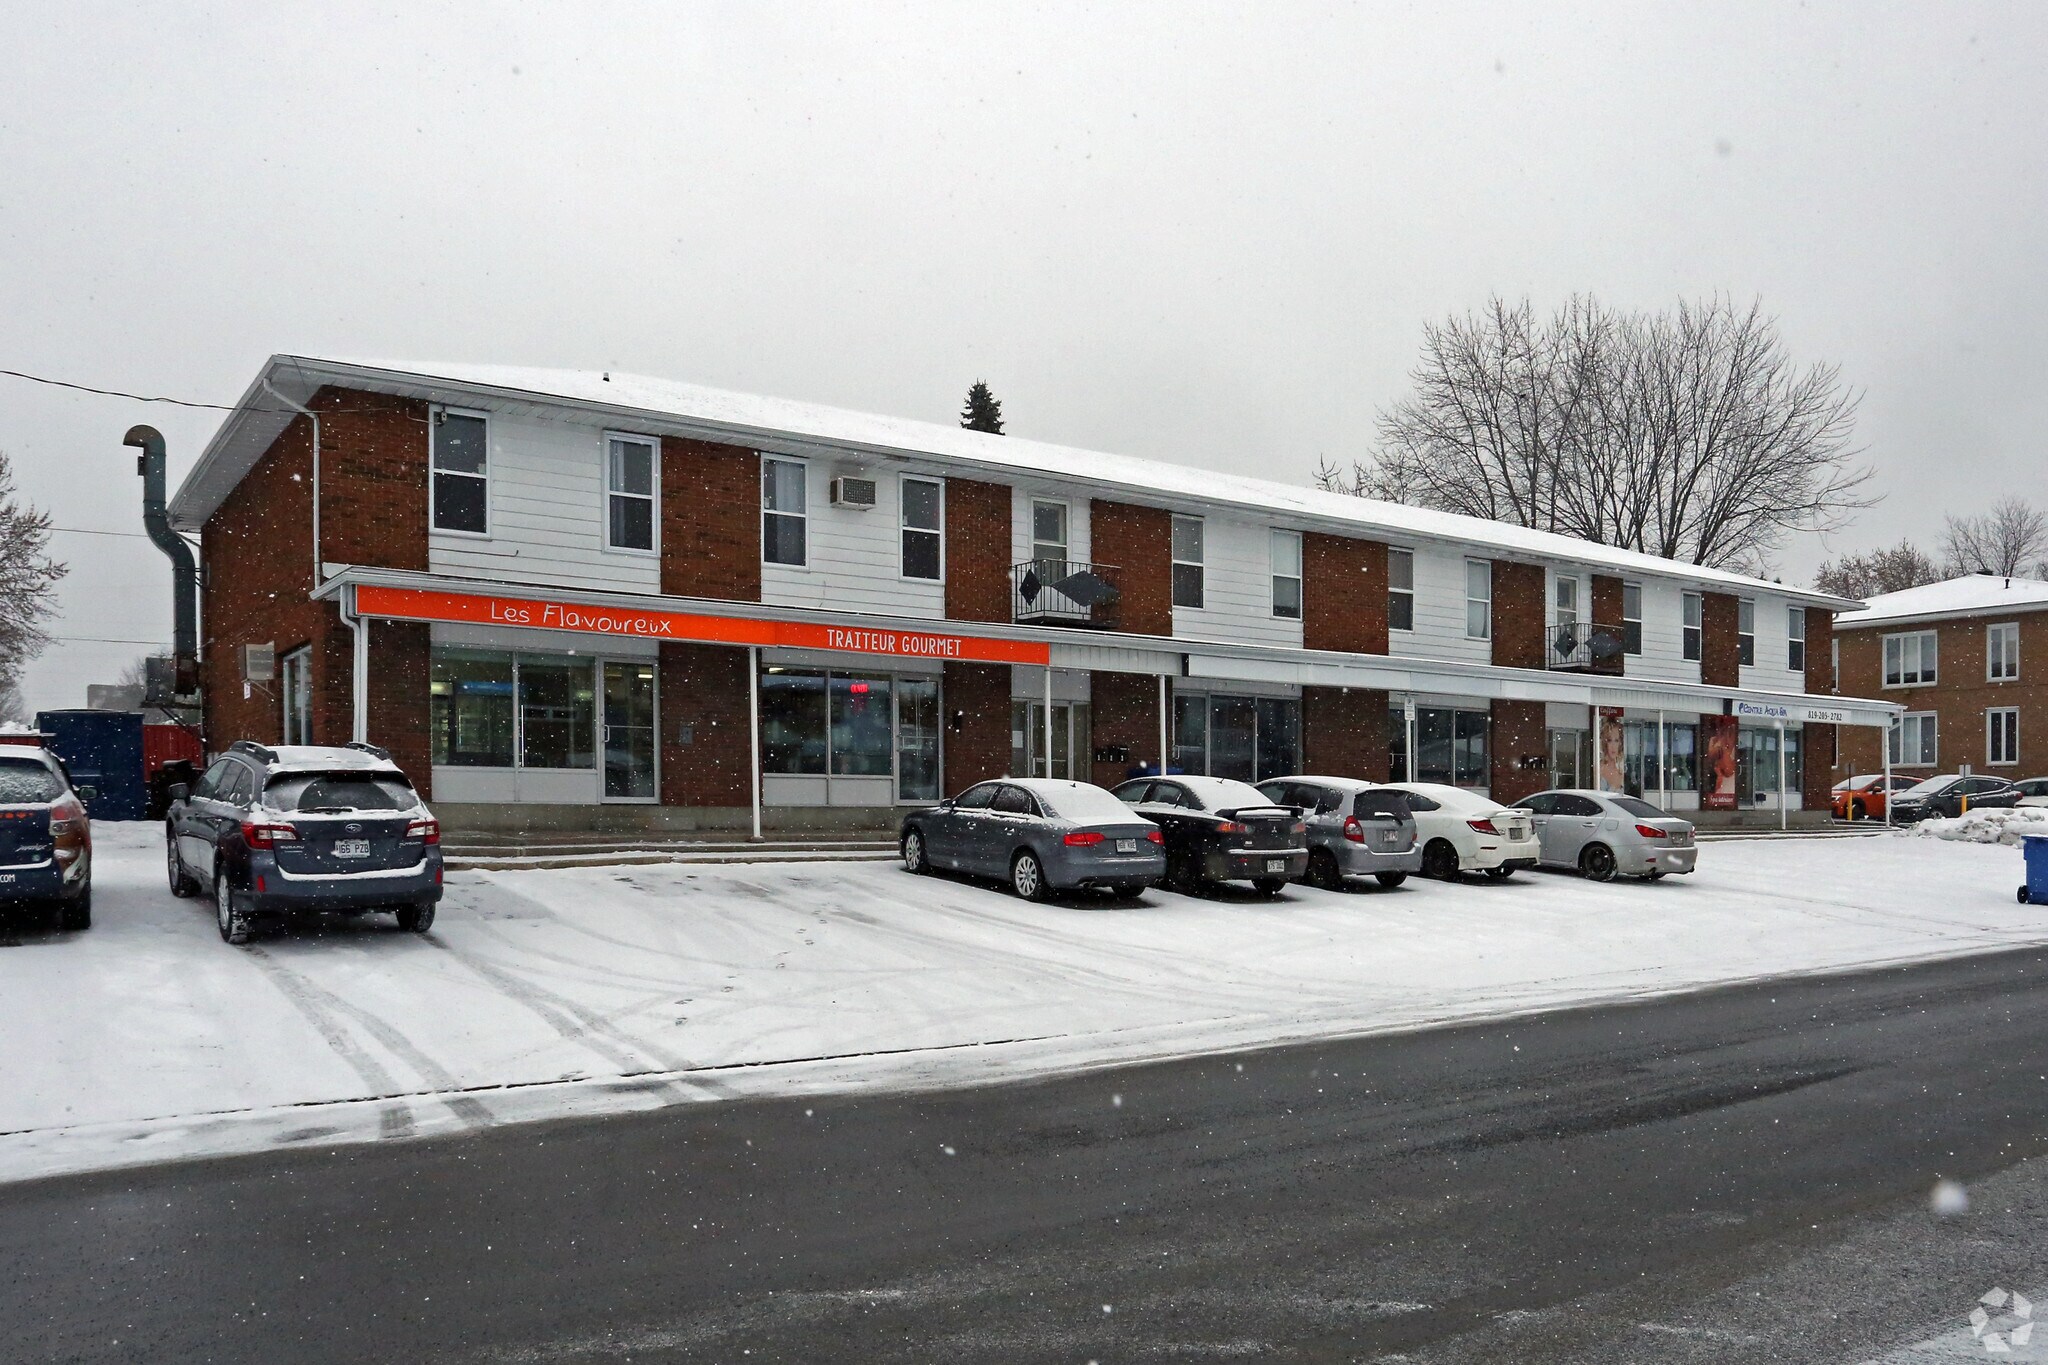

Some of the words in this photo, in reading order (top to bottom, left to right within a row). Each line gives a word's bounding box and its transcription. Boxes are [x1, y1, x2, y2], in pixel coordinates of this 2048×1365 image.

[491, 601, 530, 622] Les
[543, 604, 672, 633] Flavoureux
[827, 629, 895, 652] TRAITEUR
[902, 636, 961, 656] GOURMET
